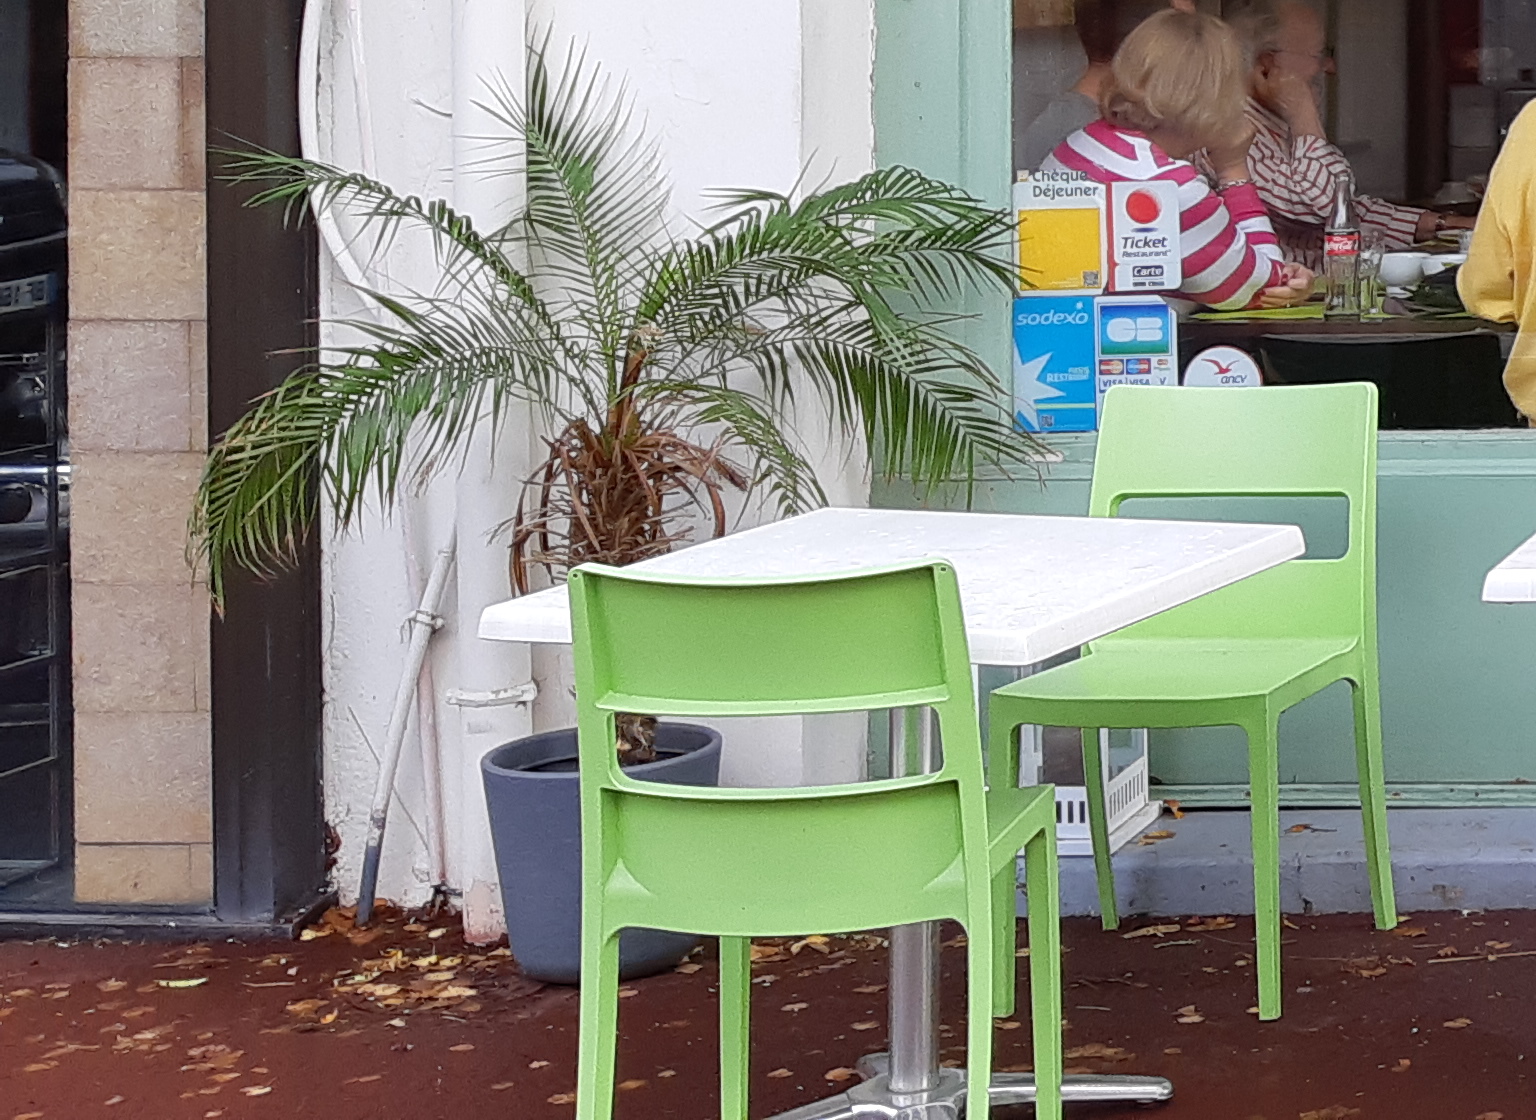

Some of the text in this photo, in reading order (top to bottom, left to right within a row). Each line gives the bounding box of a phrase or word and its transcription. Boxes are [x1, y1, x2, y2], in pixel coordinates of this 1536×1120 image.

[1032, 184, 1099, 200] Déjeuner
[1121, 235, 1168, 249] Ticket
[1016, 309, 1089, 326] sodexo
